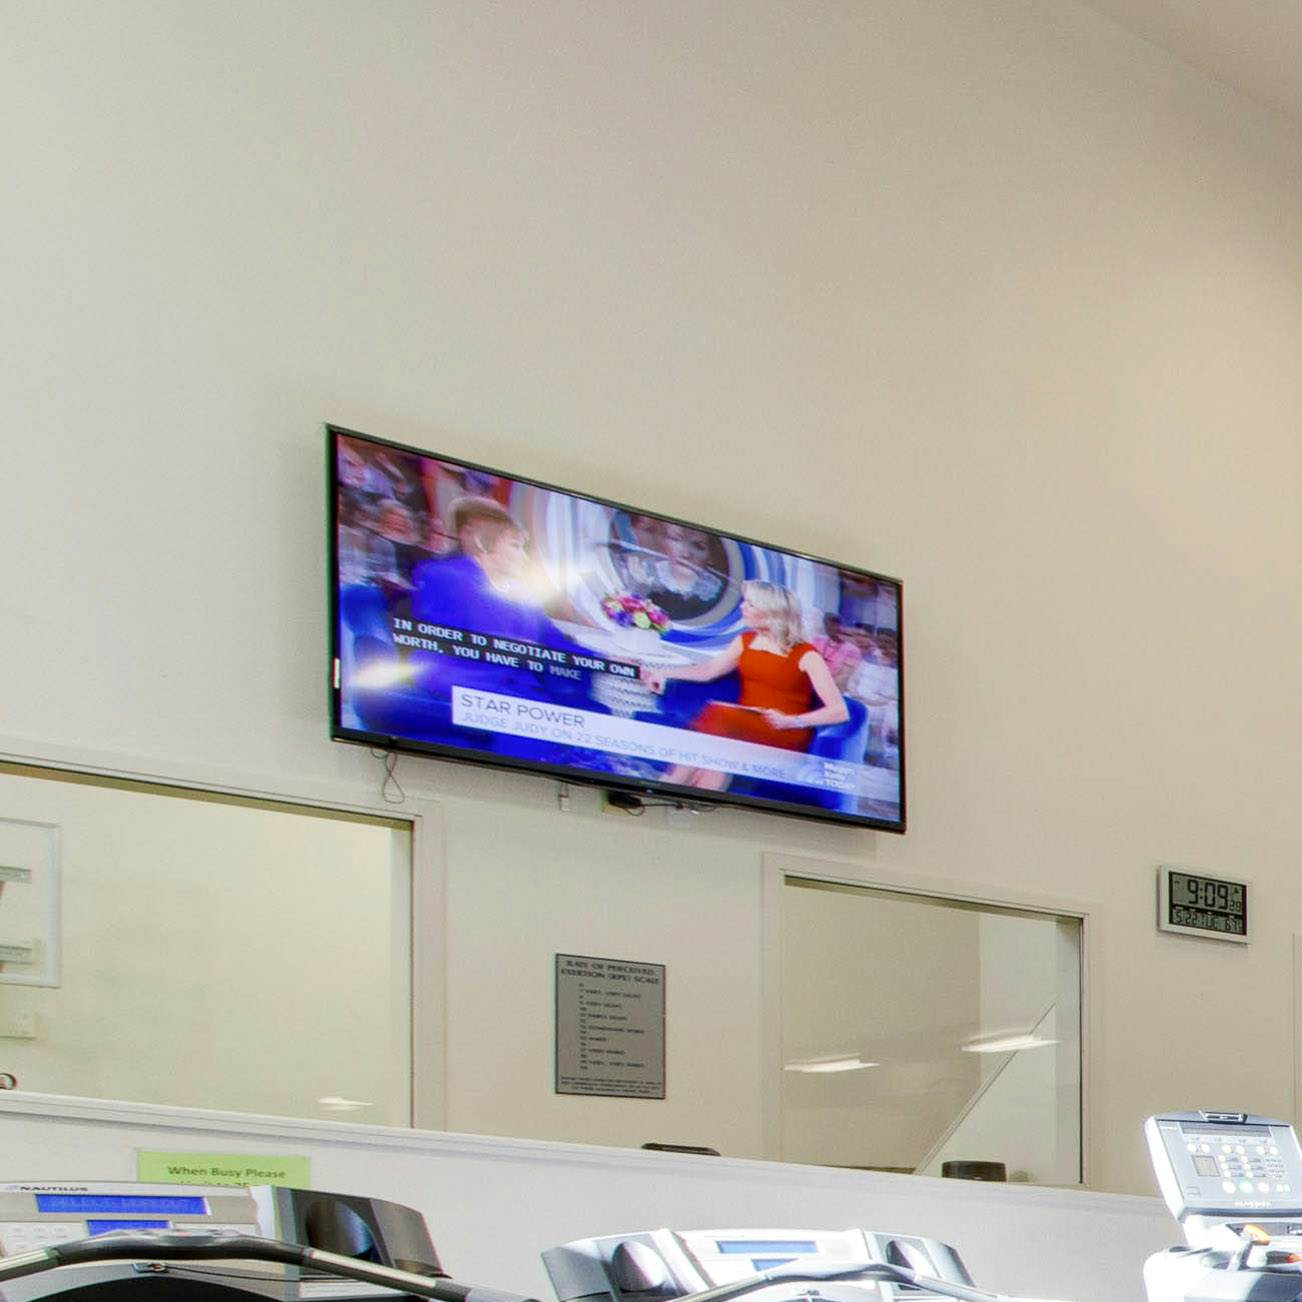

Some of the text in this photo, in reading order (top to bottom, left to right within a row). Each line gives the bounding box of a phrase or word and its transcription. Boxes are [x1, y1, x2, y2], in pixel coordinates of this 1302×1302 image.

[393, 617, 636, 677] IN ORDER TO NEGOTIATE YOUR OWN
[452, 645, 480, 660] YOU
[485, 652, 520, 668] HAVE
[527, 660, 543, 673] TO
[550, 665, 581, 680] MAKE
[461, 694, 585, 728] STAR POWER
[1187, 879, 1228, 910] 9:09
[167, 1166, 286, 1179] When Busy Please
